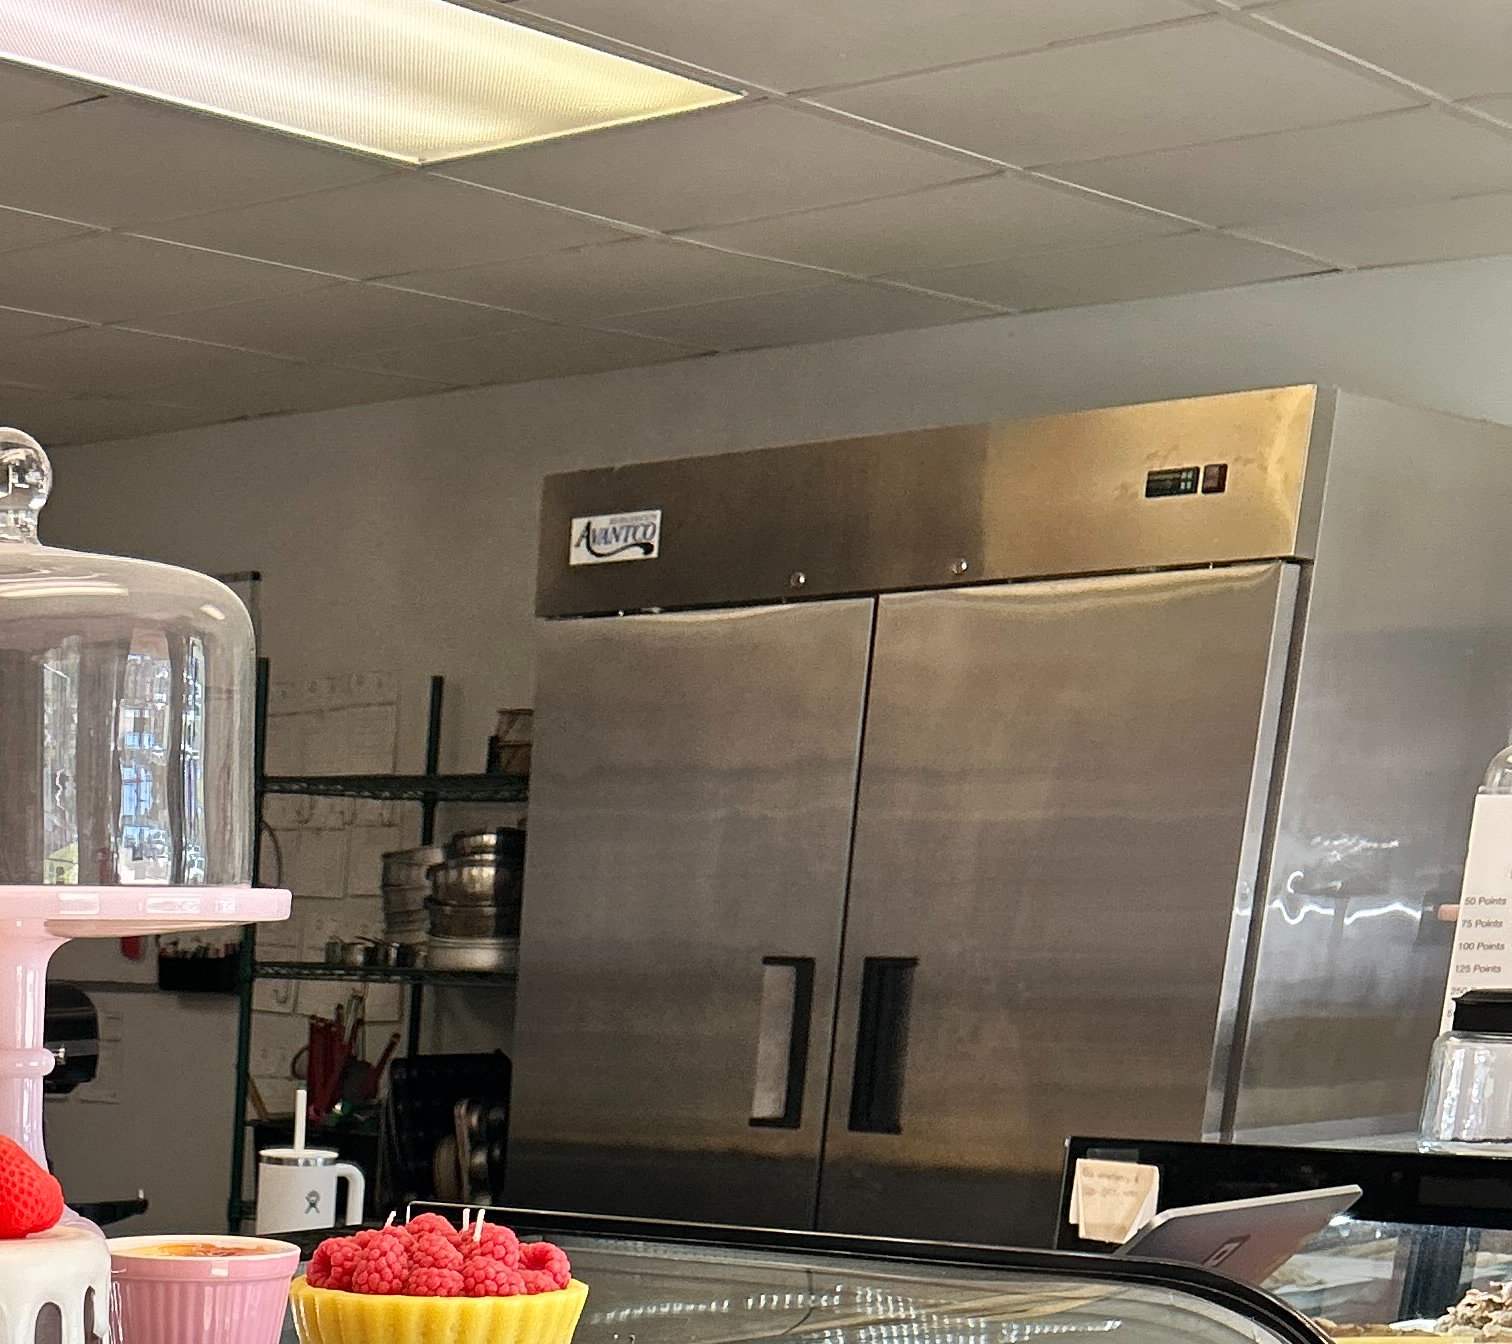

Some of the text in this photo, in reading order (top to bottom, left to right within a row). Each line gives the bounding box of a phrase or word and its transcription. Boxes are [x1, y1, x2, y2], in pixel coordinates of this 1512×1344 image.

[574, 521, 657, 555] AVANTCO
[1478, 896, 1507, 905] Points
[1475, 919, 1503, 928] Points
[1459, 942, 1505, 950] 100 Points
[1455, 965, 1501, 973] 125 Points
